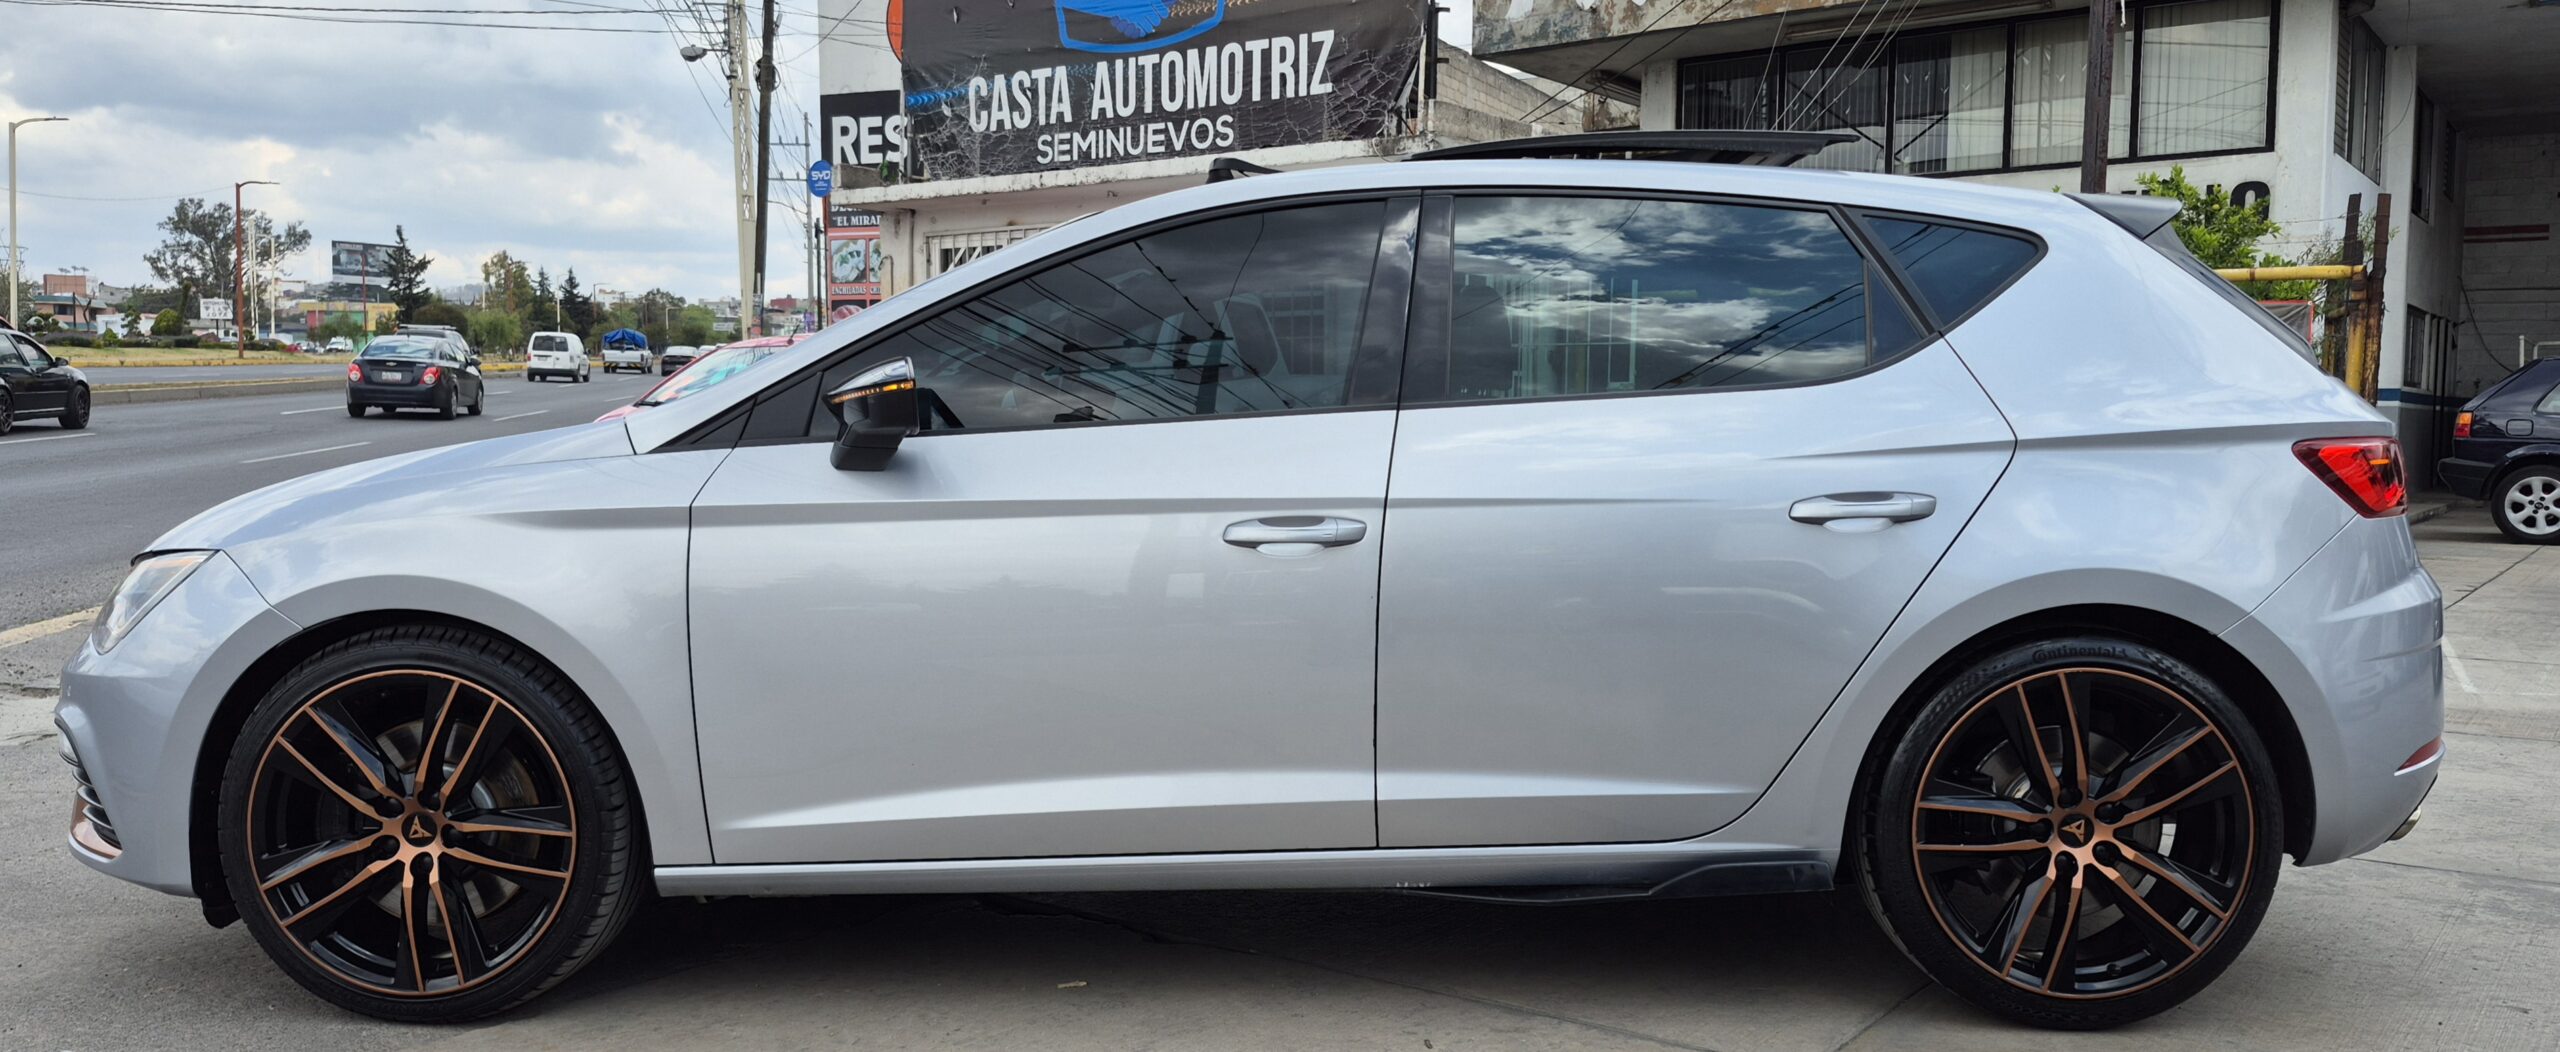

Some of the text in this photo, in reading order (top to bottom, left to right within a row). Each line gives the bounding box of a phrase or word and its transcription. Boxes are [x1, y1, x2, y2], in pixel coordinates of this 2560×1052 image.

[968, 29, 1335, 133] CASTA AUTOMOTRIZ
[831, 114, 909, 166] RES
[1036, 115, 1235, 165] SEMINUEVOS
[811, 170, 831, 181] SYD
[2032, 645, 2117, 664] Continental
